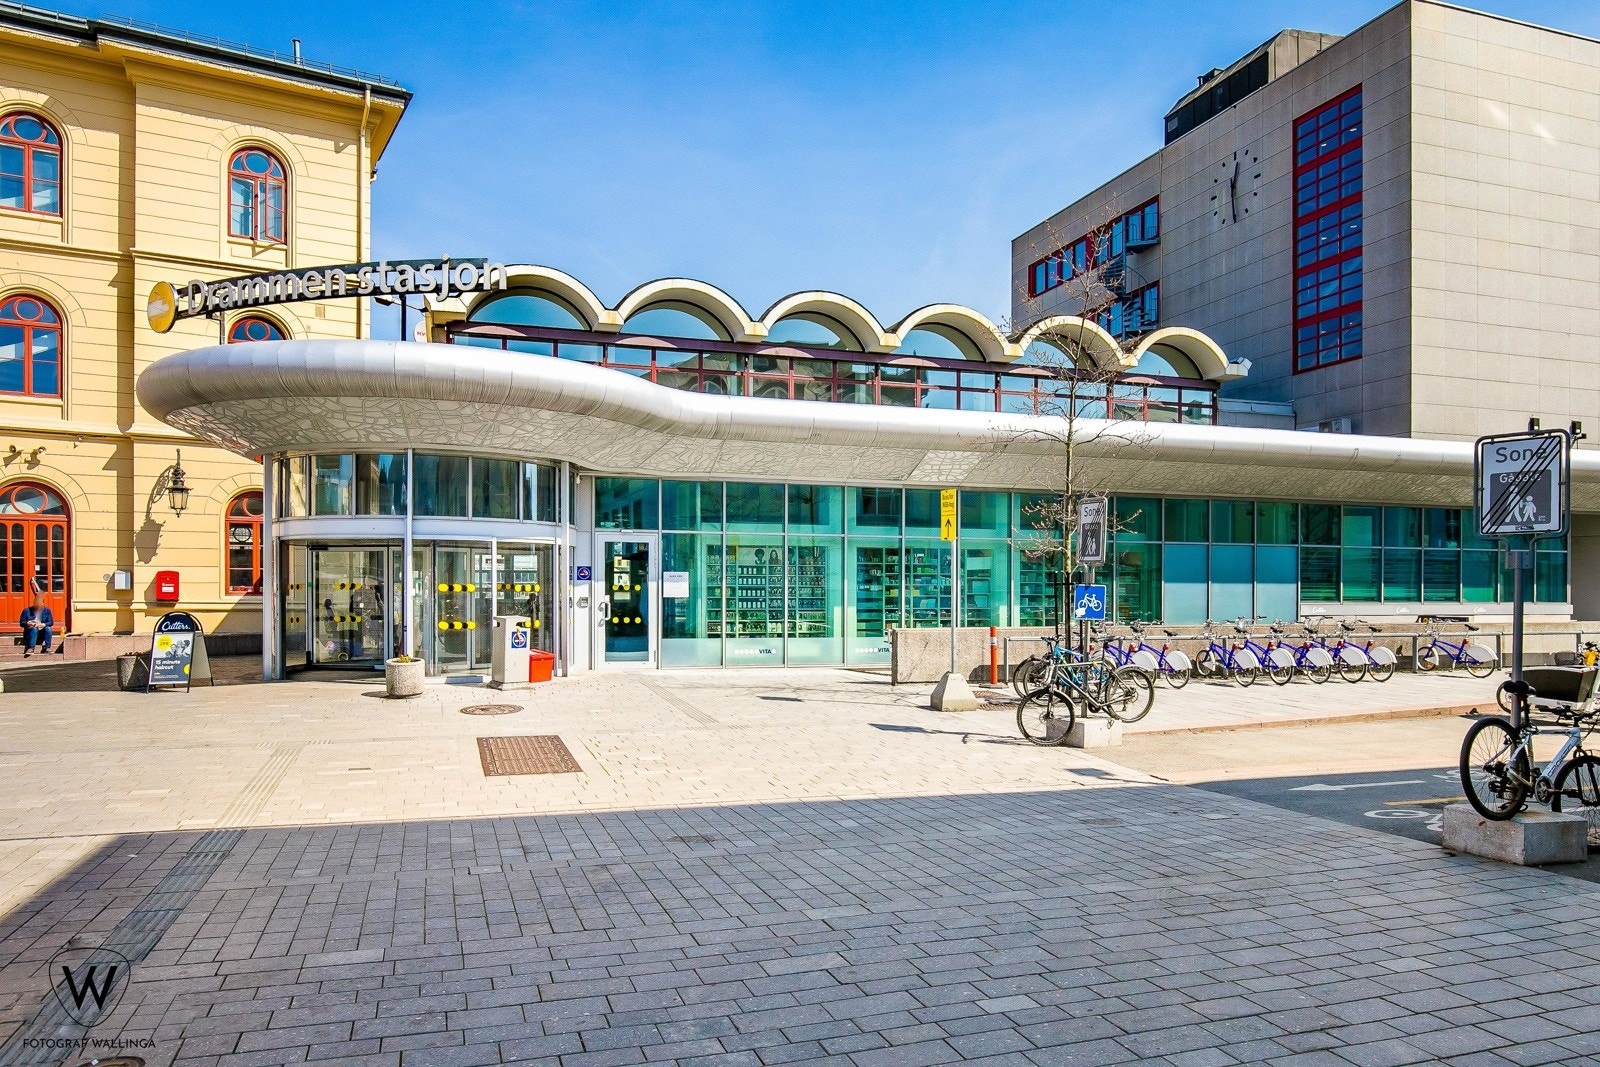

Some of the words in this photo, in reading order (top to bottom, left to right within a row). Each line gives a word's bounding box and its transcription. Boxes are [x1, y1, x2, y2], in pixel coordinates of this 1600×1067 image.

[187, 265, 347, 315] Drammen
[357, 253, 507, 302] stasjon
[1495, 446, 1548, 463] Sone
[1084, 506, 1101, 517] Sone
